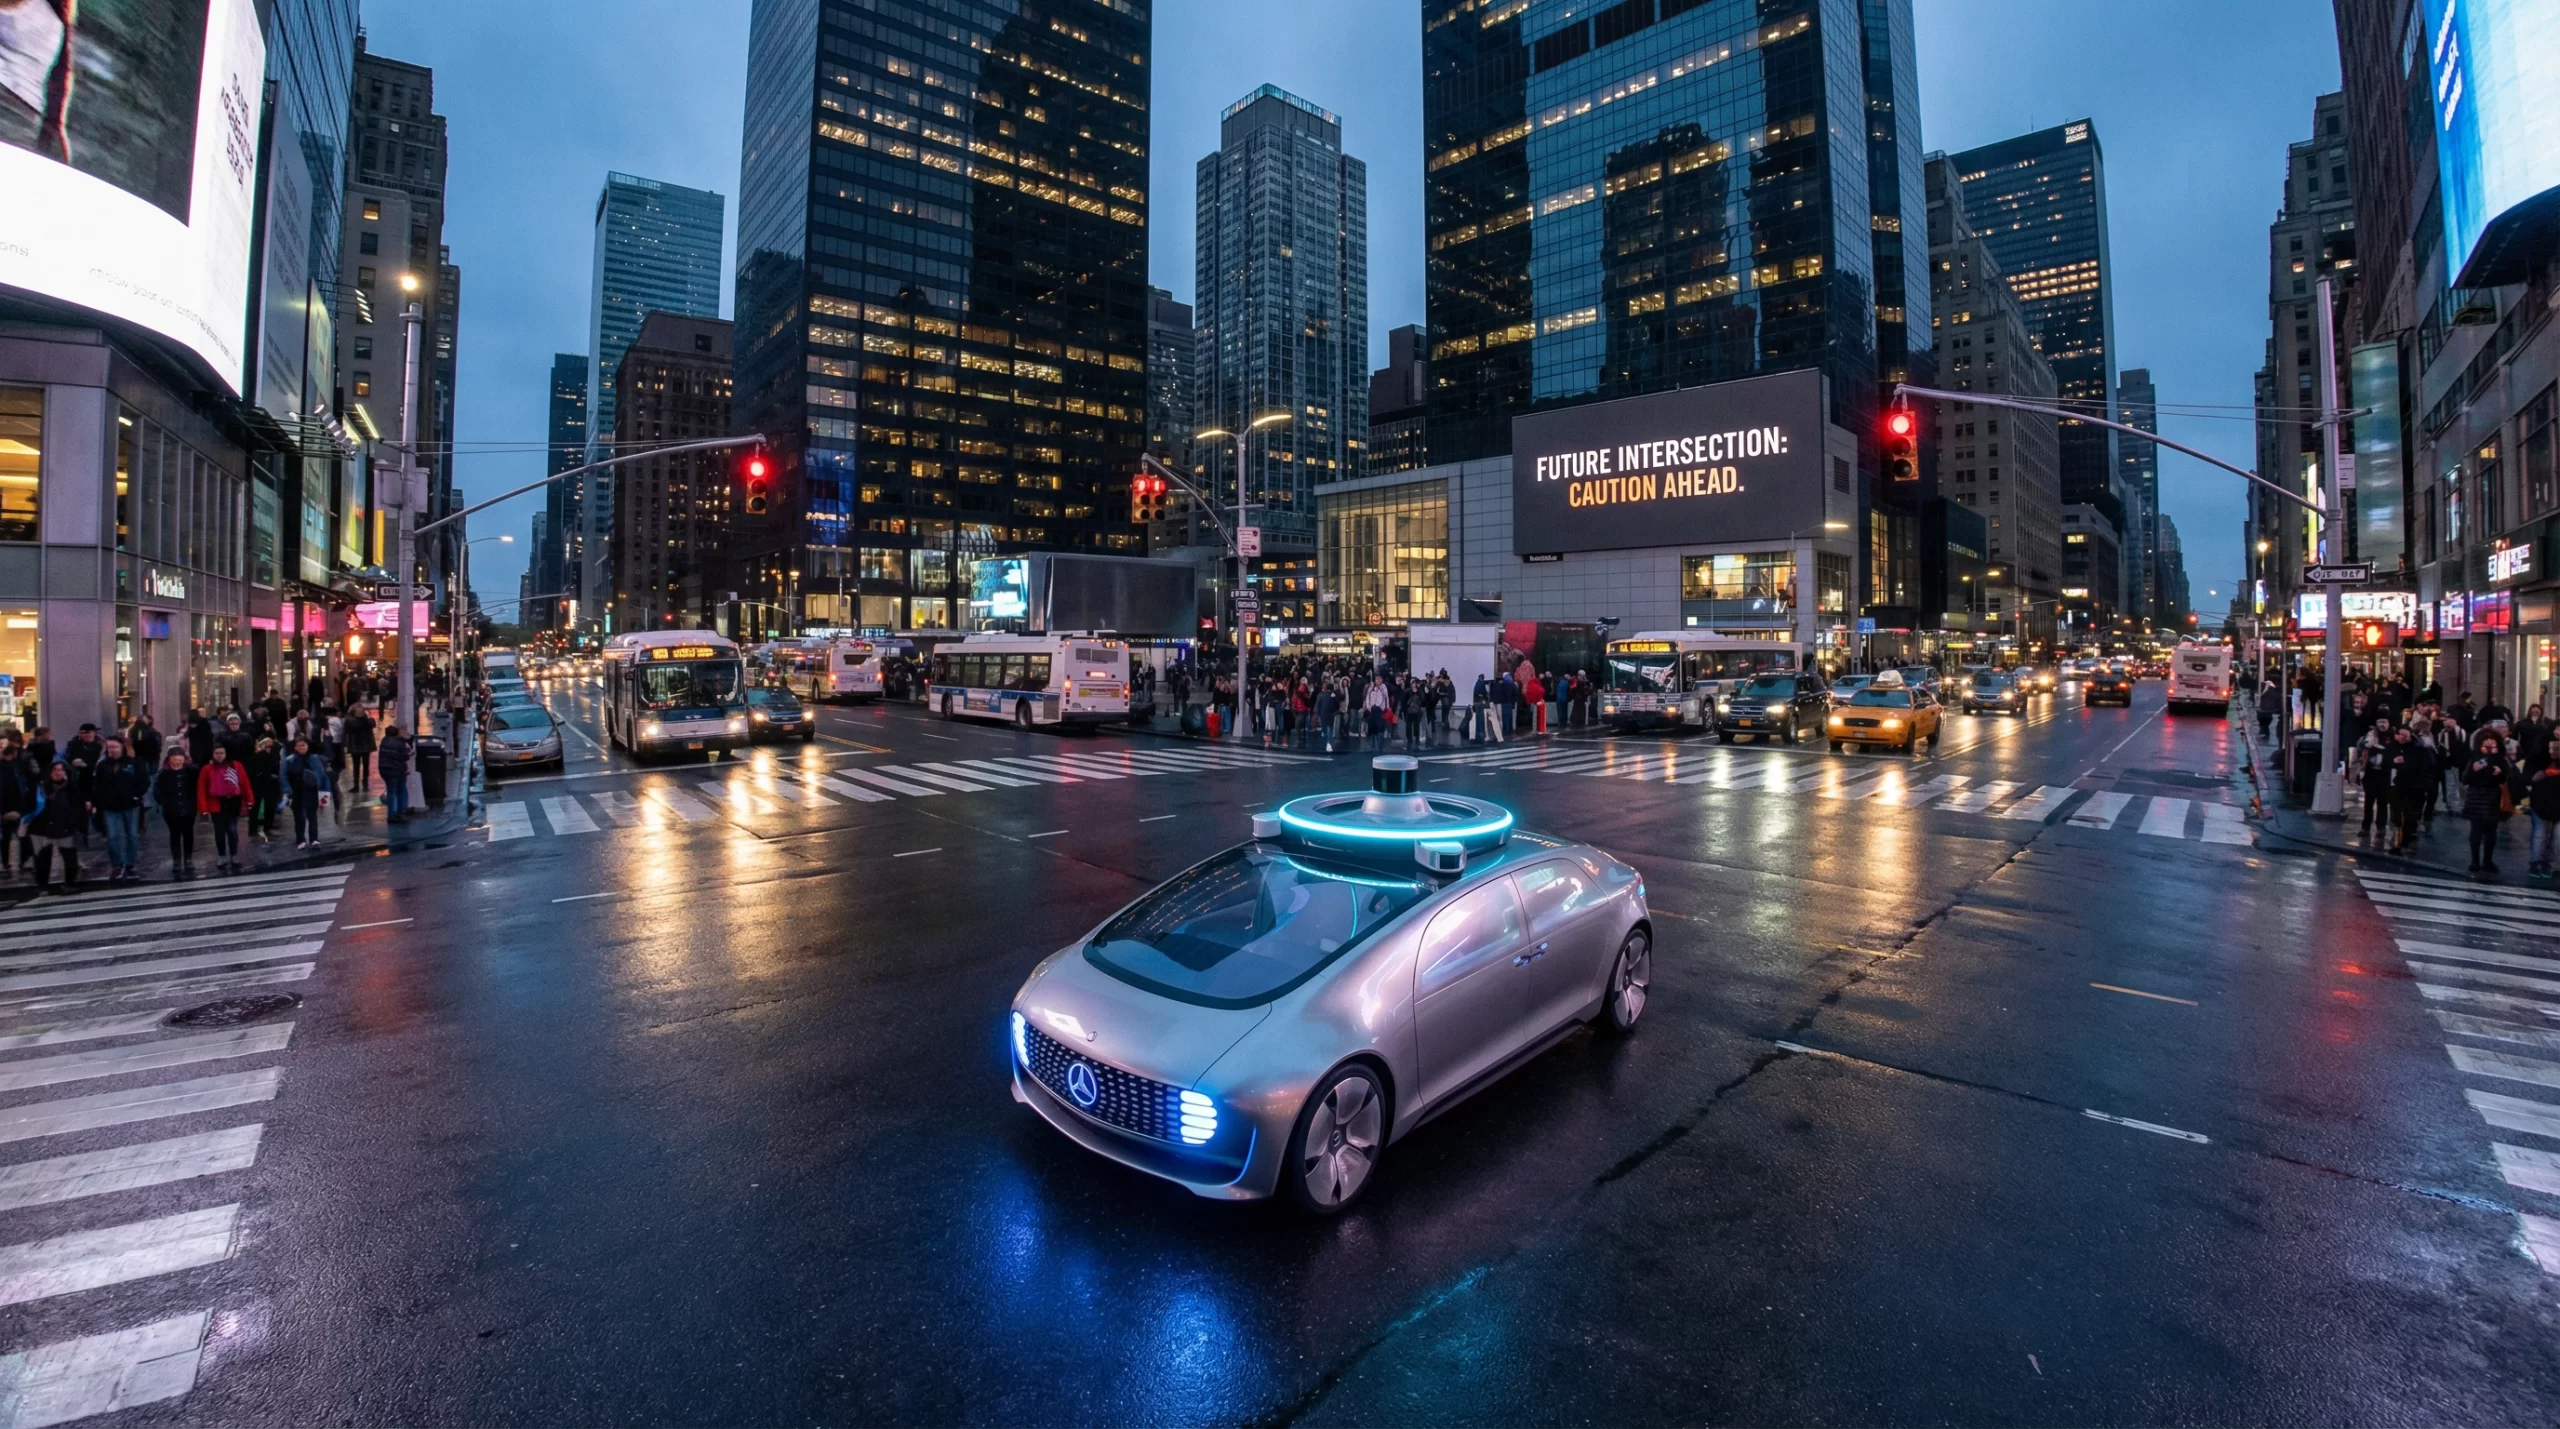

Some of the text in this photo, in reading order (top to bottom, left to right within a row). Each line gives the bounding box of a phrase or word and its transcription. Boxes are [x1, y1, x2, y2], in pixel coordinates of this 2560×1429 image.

[1536, 426, 1788, 482] FUTURE INTERSECTION:
[1569, 466, 1745, 507] CAUTION AHEAD.
